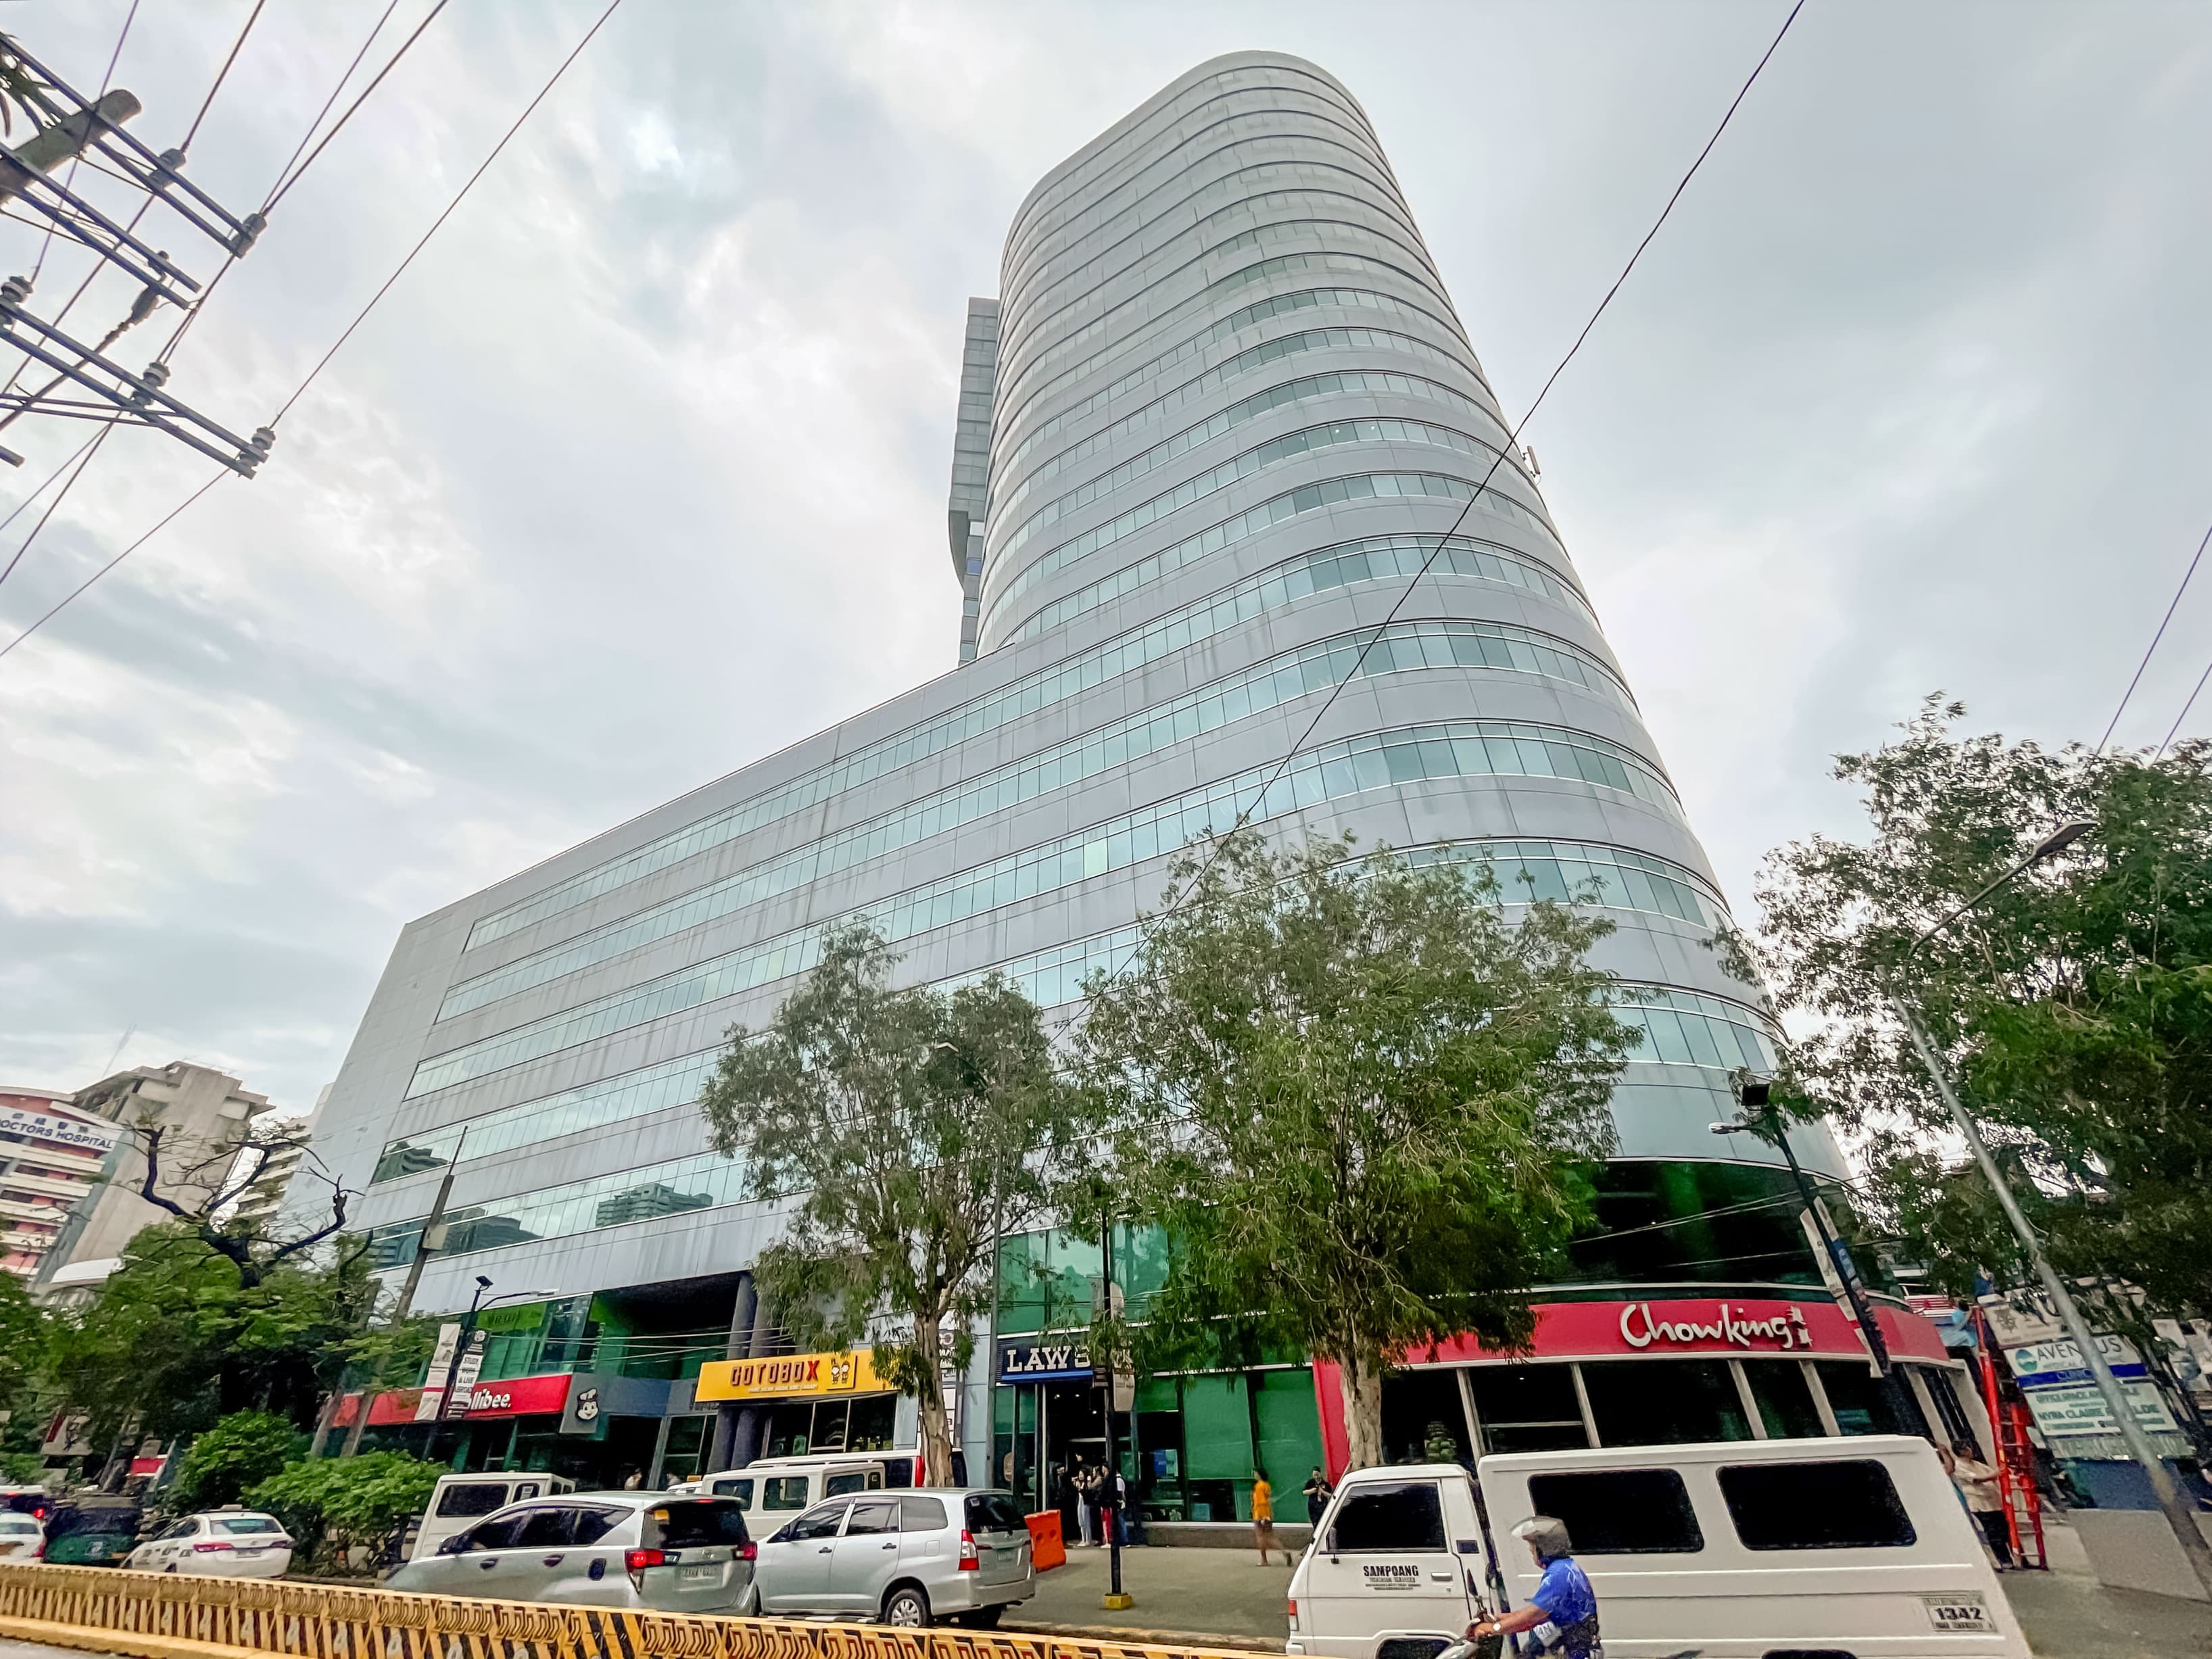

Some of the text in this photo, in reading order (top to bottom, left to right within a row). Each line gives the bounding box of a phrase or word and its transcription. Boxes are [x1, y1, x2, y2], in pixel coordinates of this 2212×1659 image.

[55, 1130, 112, 1149] HOSPITAL
[1620, 1303, 1793, 1349] Chowking
[2038, 1337, 2122, 1362] AVENUS
[470, 1389, 509, 1410] llibee
[1935, 1606, 1984, 1620] 1342
